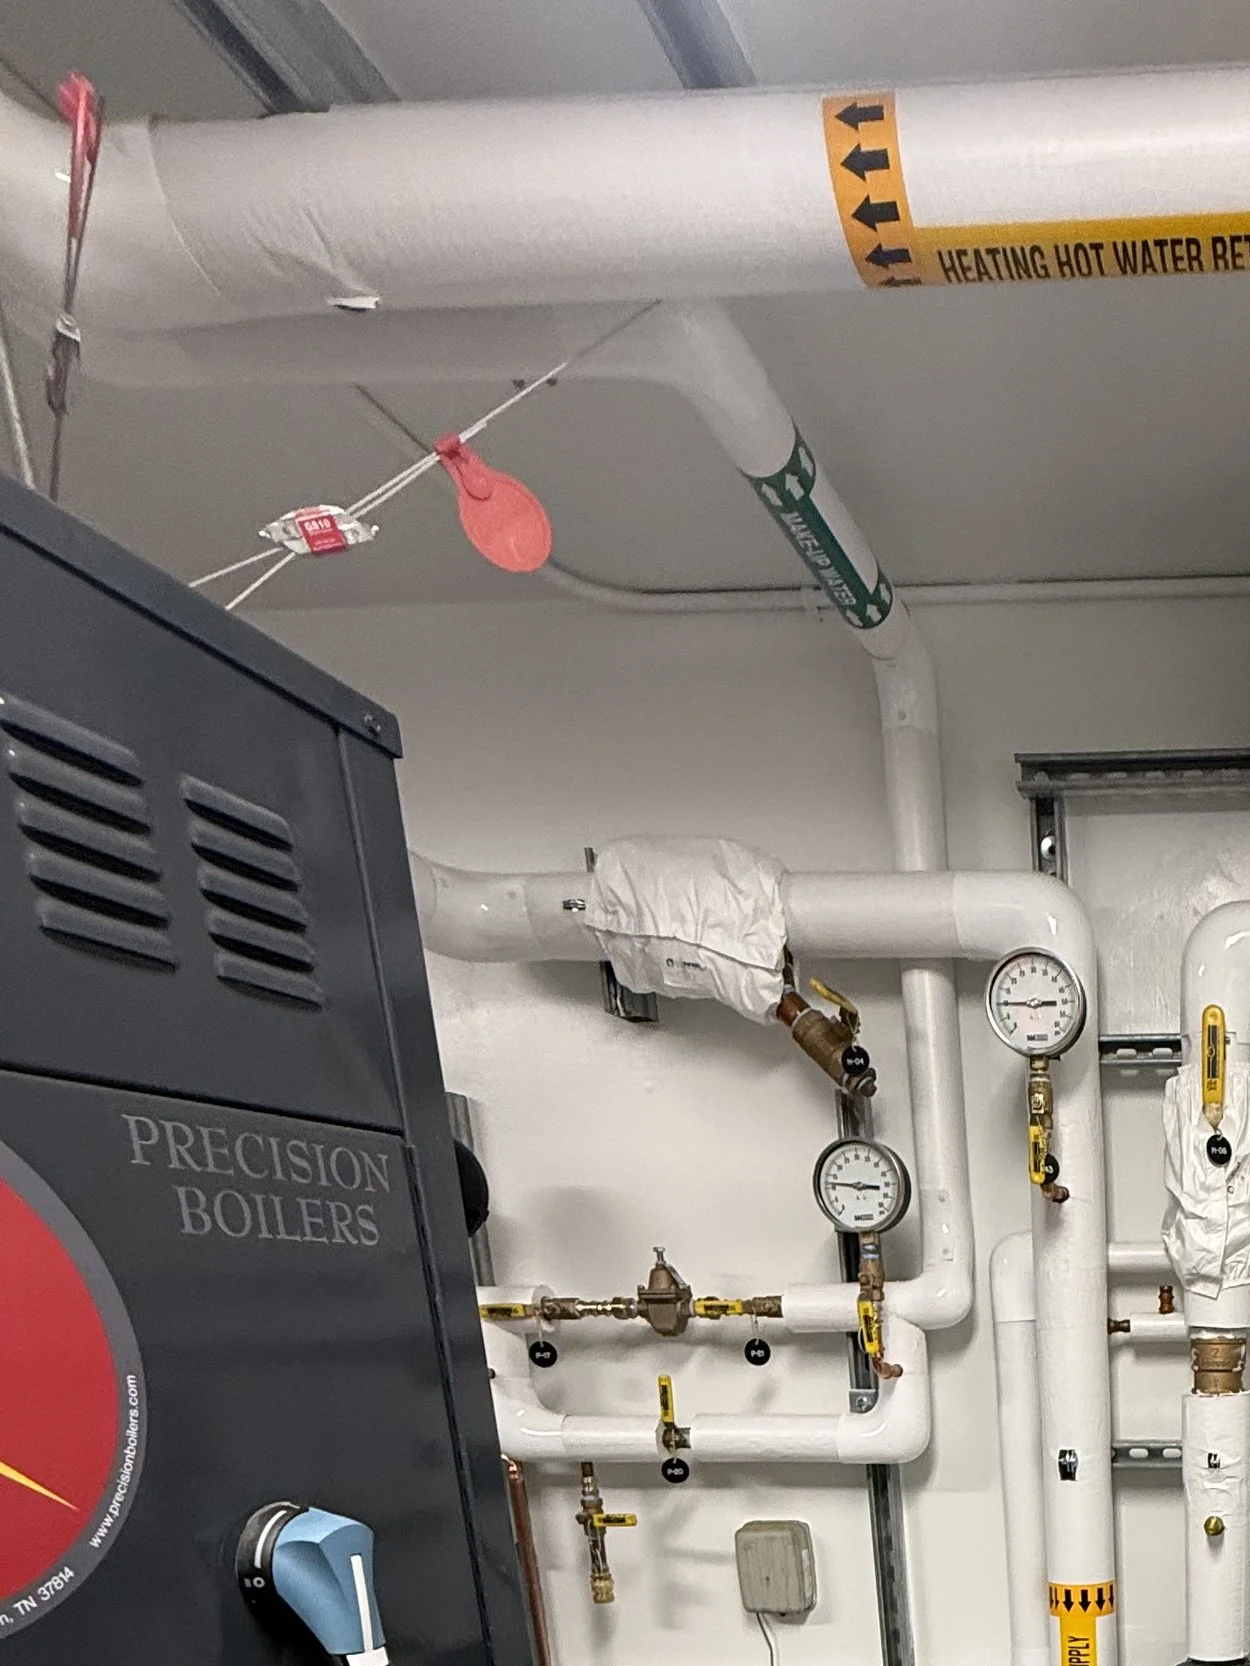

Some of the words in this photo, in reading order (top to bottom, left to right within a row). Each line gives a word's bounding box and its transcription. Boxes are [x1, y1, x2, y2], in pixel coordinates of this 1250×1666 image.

[936, 244, 1049, 284] HEATING
[1054, 242, 1104, 279] HOT
[1112, 237, 1203, 275] WATER
[121, 1114, 390, 1193] PRECISION
[173, 1185, 381, 1246] BOILERS
[89, 1374, 139, 1549] www.precisionboilers.com
[13, 1594, 38, 1617] TN
[37, 1566, 75, 1602] 37814
